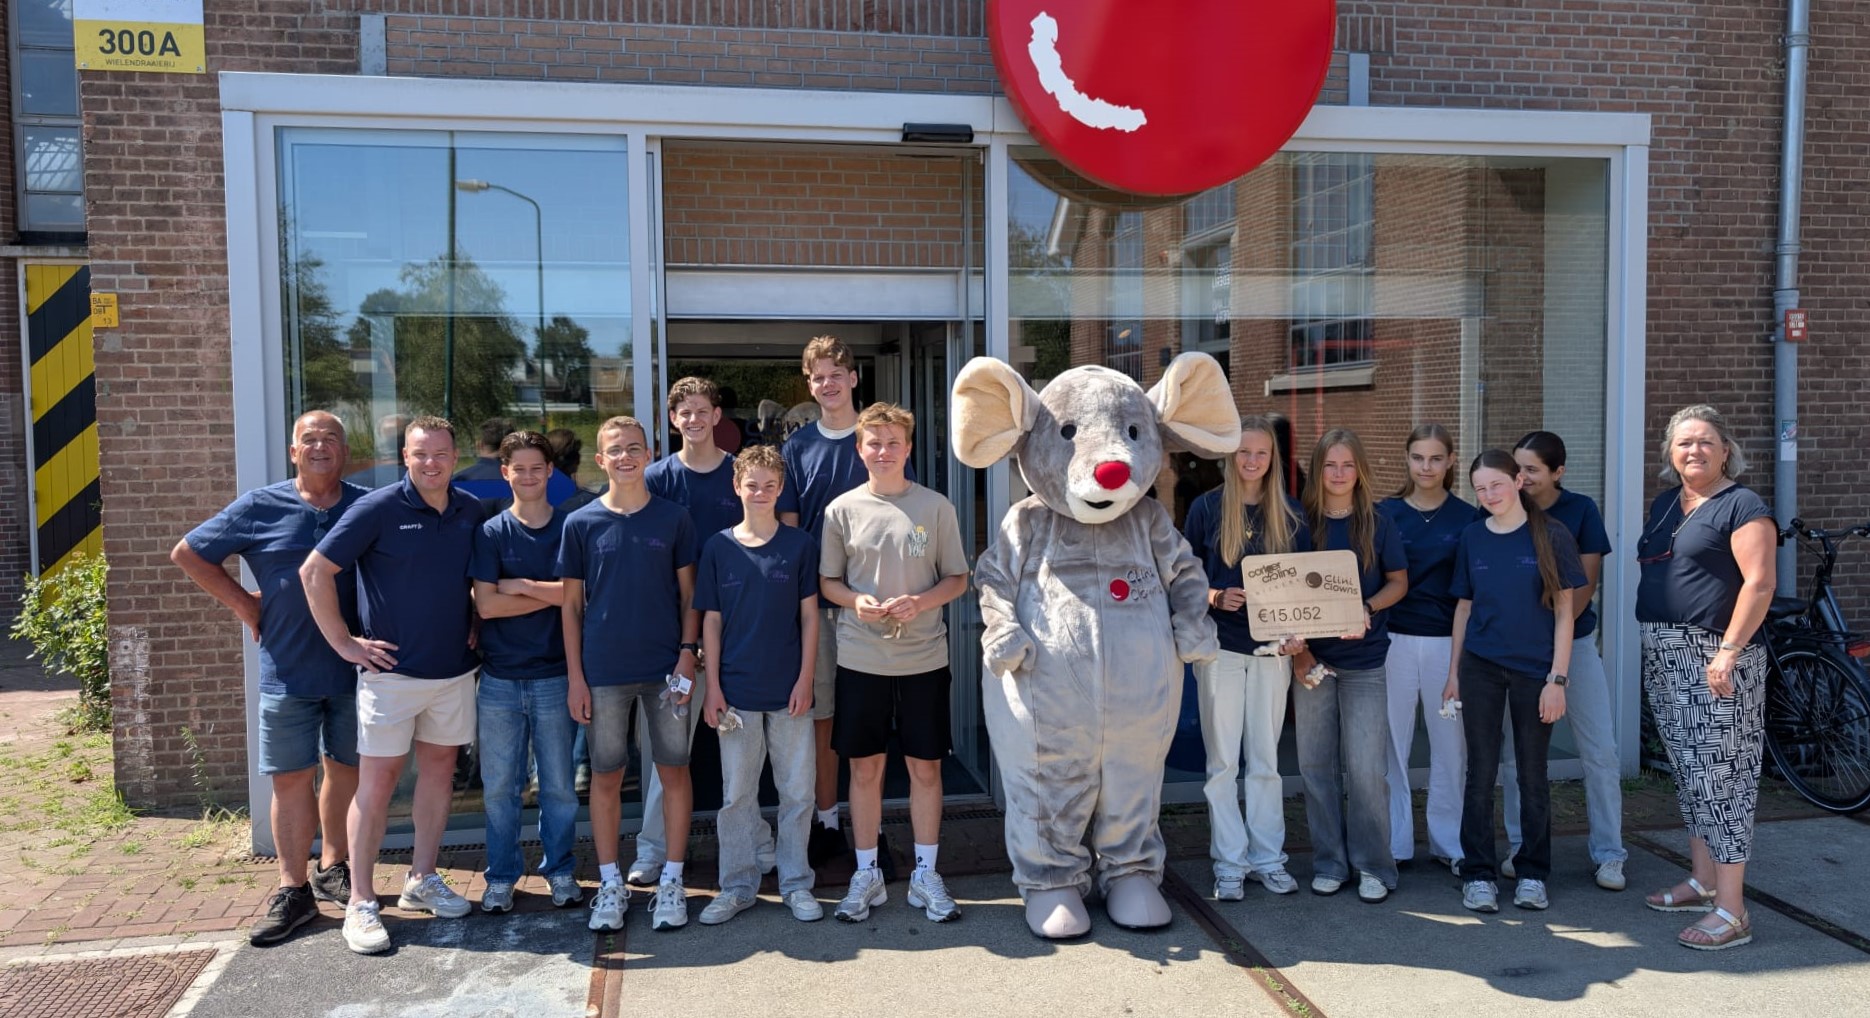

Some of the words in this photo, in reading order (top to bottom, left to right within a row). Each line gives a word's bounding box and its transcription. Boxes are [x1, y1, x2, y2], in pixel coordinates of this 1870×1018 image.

[98, 28, 182, 57] 300A
[105, 58, 176, 68] WIELENDRAAIERIJ
[1324, 574, 1354, 586] Clini
[1323, 582, 1358, 595] Clowns
[1257, 606, 1322, 623] €15.052
